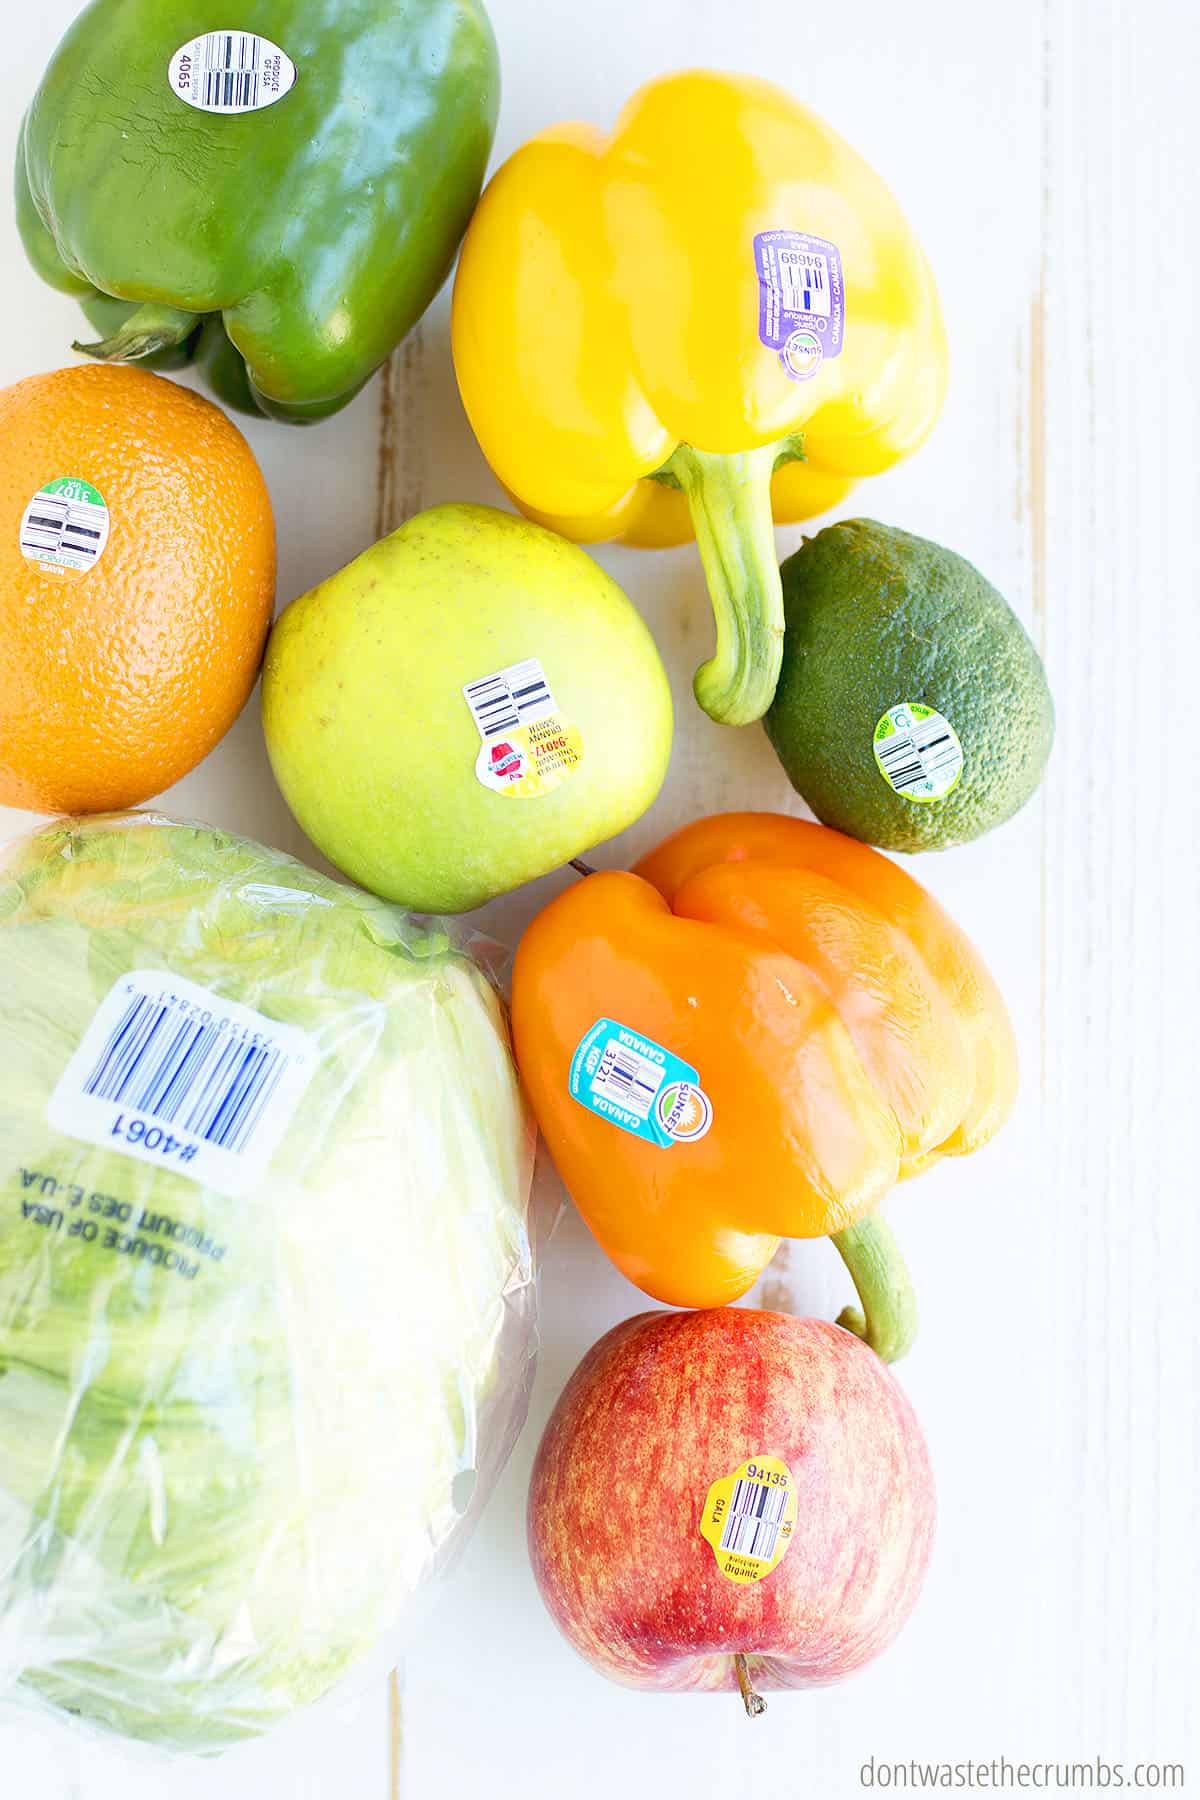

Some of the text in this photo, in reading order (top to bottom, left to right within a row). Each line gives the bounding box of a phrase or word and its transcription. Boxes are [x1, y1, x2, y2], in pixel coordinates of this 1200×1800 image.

[178, 55, 192, 89] 4065
[263, 59, 272, 87] OF USA
[271, 55, 281, 92] PRODUCE
[781, 252, 822, 268] 94689
[832, 303, 841, 344] CANADA
[786, 342, 822, 355] SUNSET
[55, 485, 91, 502] 3107
[67, 480, 82, 489] USA
[528, 717, 556, 734] SMITH
[528, 725, 562, 744] GRANNY
[156, 990, 212, 1023] 02841
[584, 1045, 602, 1076] KGF
[619, 1029, 666, 1064] CANADA
[596, 1049, 617, 1083] 3121
[592, 1095, 641, 1129] CANADA
[663, 1082, 690, 1133] SUNSET
[111, 1114, 200, 1163] #4061
[88, 1192, 133, 1223] DES
[20, 1199, 201, 1280] PRODUCE OF USA
[138, 1208, 227, 1261] PRODUIT
[746, 1464, 788, 1487] 94135
[711, 1498, 726, 1523] GALA
[780, 1520, 793, 1539] USA
[724, 1562, 759, 1579] Organic
